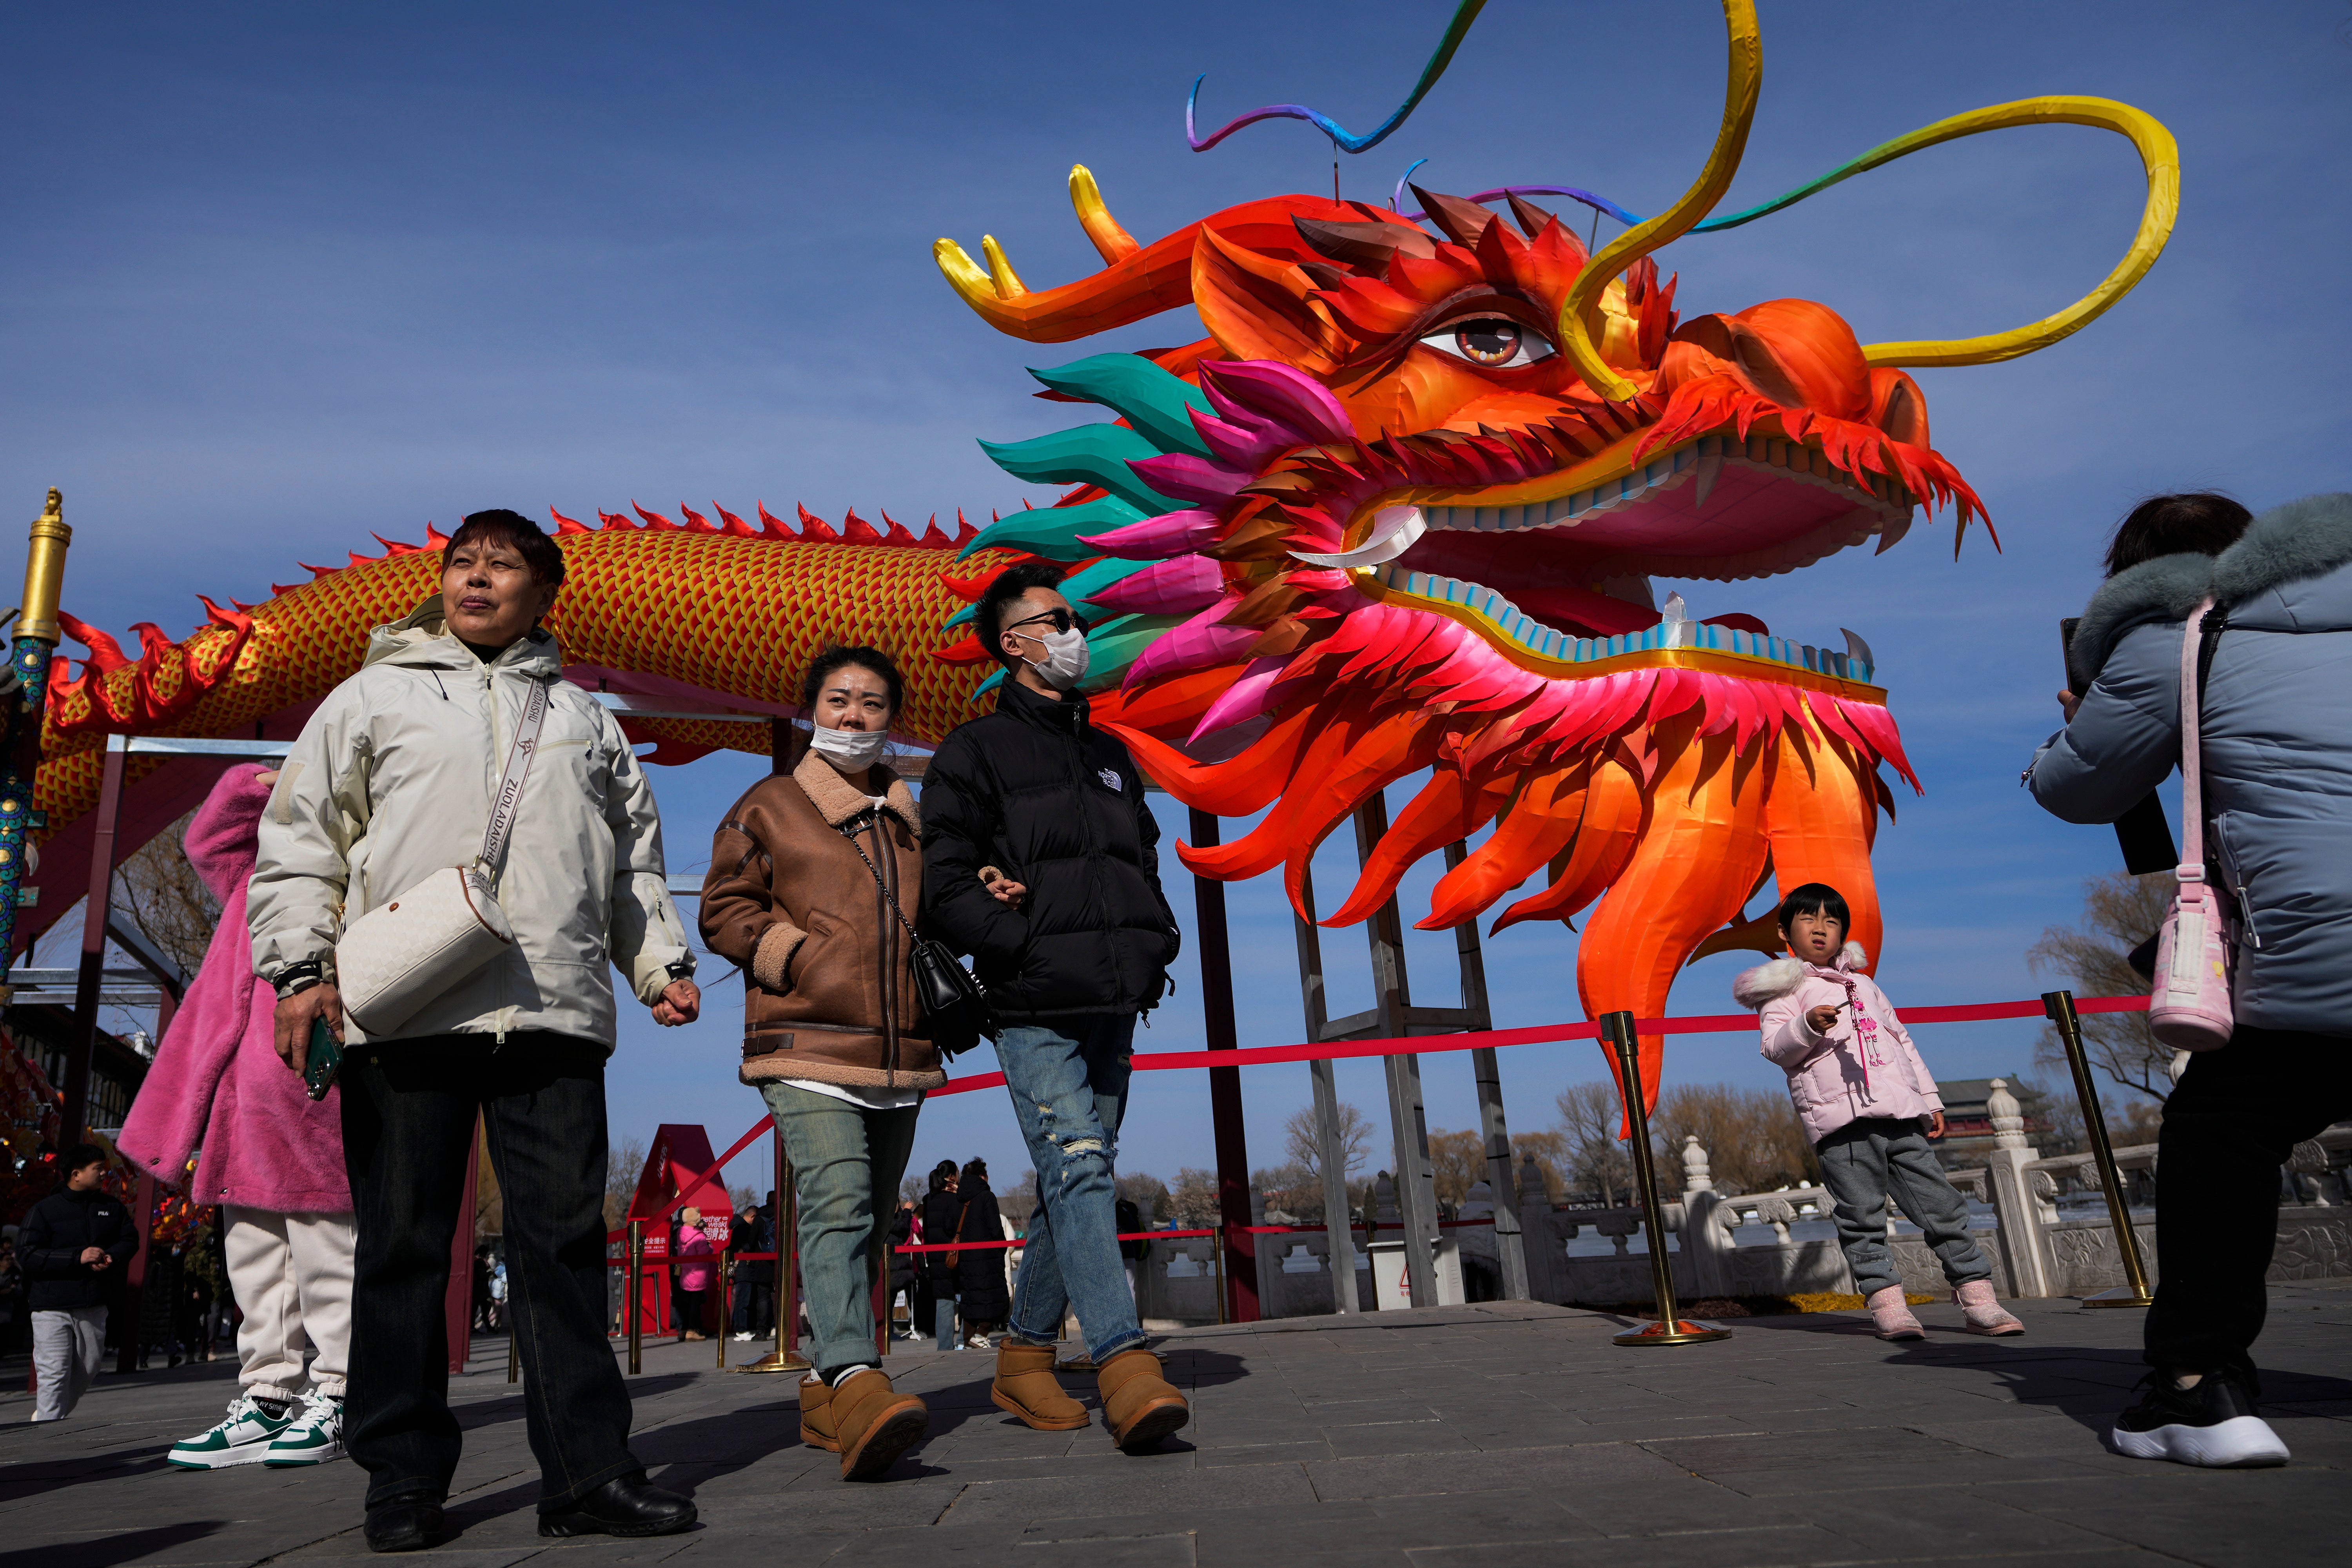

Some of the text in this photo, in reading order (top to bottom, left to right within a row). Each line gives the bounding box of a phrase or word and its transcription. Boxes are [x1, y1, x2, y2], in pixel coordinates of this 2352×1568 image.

[1098, 771, 1114, 782] NORTH
[1104, 768, 1114, 777] THE
[1103, 778, 1114, 788] FACE
[269, 1403, 286, 1412] SMART
